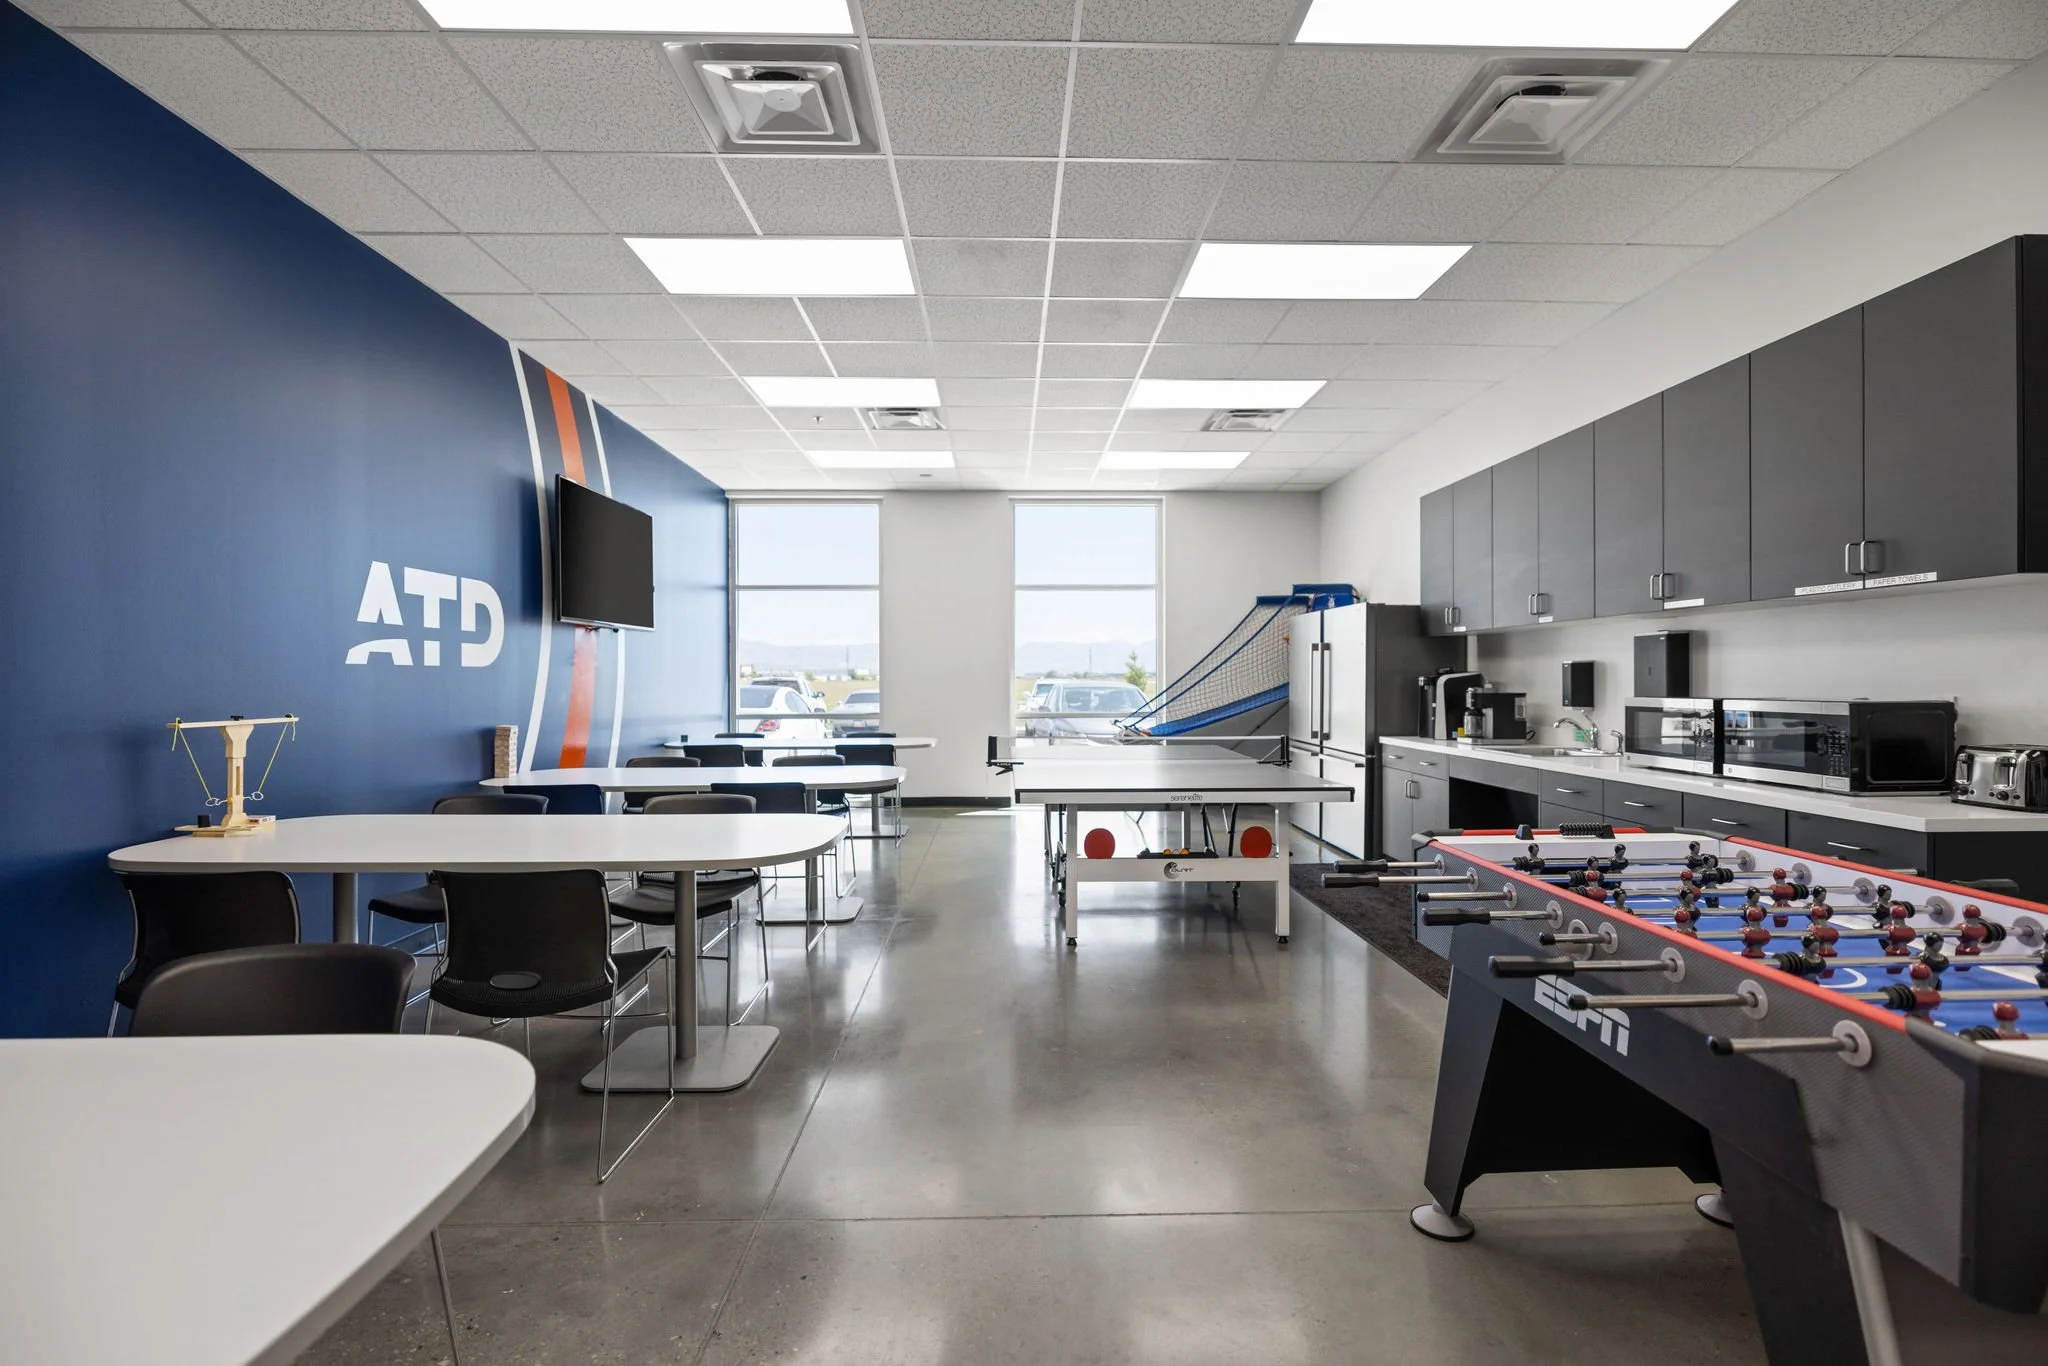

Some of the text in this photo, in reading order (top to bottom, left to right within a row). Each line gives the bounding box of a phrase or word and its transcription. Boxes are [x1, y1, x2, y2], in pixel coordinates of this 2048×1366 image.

[345, 560, 504, 667] ATD
[1873, 573, 1929, 586] PAPER TOWELS
[1534, 974, 1630, 1057] ESPN
